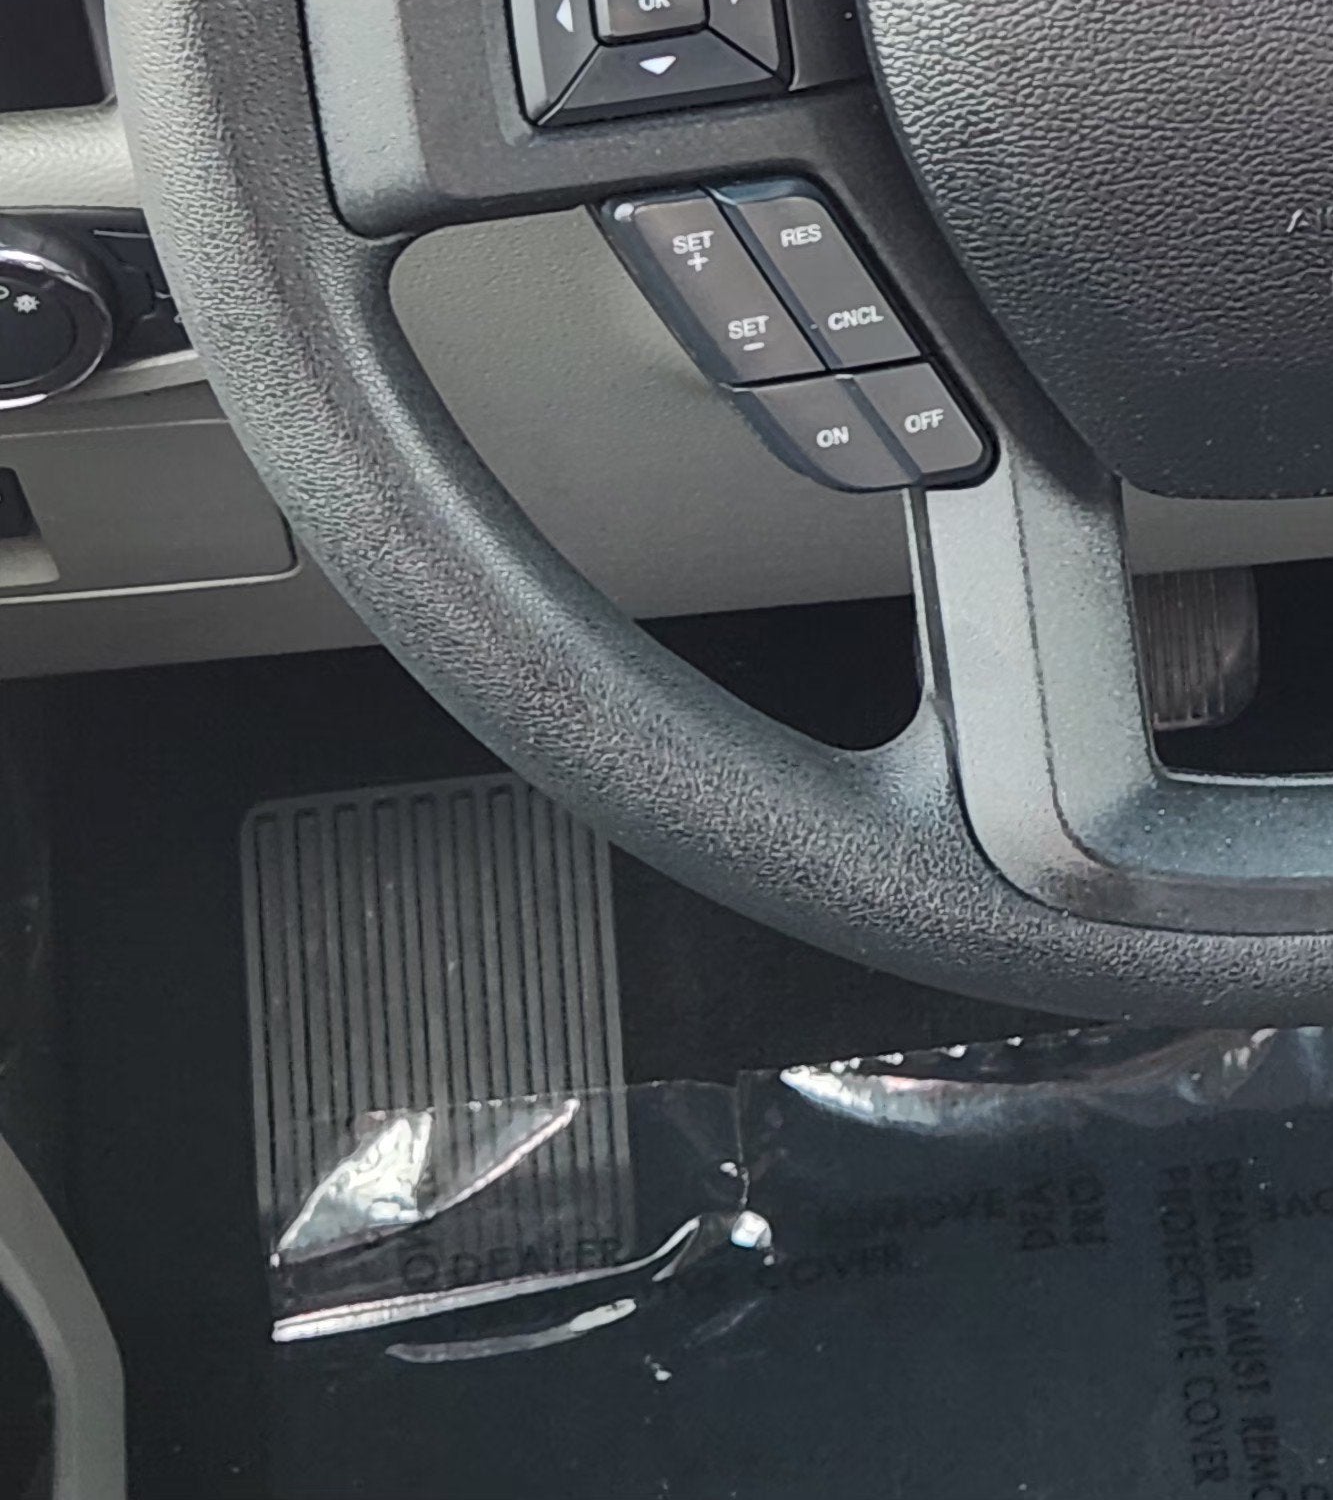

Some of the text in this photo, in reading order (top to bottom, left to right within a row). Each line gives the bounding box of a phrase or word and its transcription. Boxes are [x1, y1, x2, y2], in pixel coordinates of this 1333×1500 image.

[672, 231, 714, 254] SET
[780, 223, 823, 247] RES
[728, 315, 769, 339] SET
[828, 305, 884, 331] CNCL
[904, 409, 944, 434] OFF
[816, 426, 849, 448] ON
